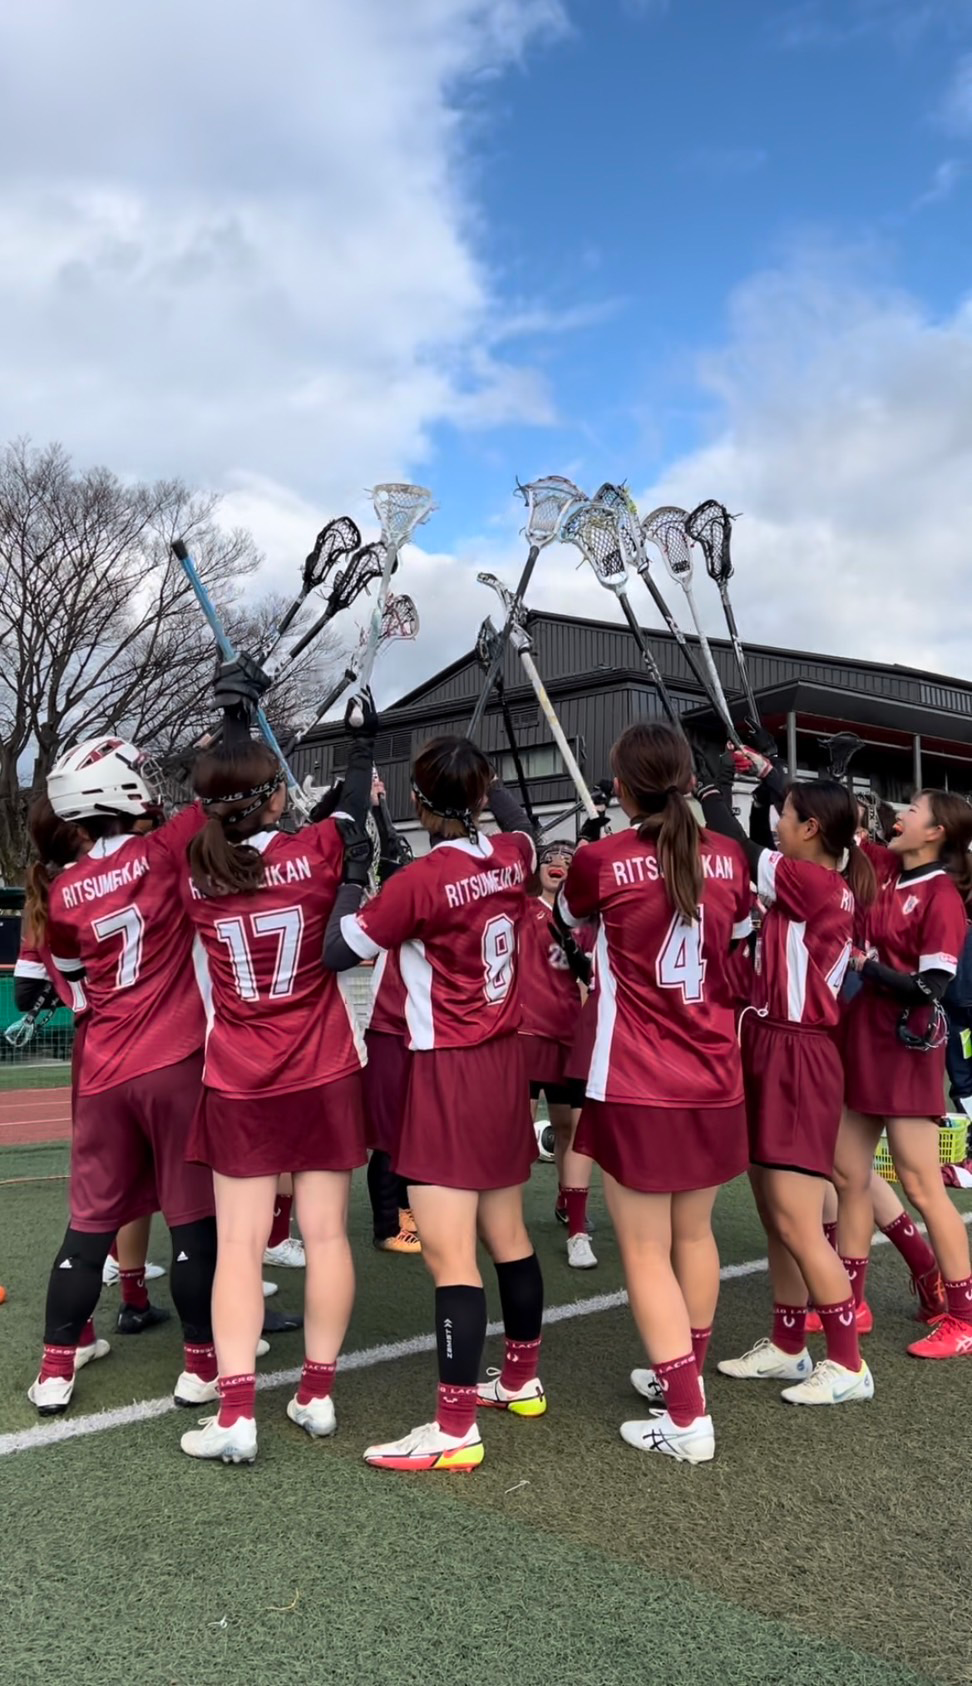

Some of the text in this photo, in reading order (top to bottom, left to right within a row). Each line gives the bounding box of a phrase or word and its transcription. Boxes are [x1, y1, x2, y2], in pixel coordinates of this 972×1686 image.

[612, 854, 734, 886] RITSKAN
[91, 902, 145, 990] 7
[214, 905, 305, 1002] 17
[481, 912, 515, 1006] 8
[655, 903, 708, 1005] 4
